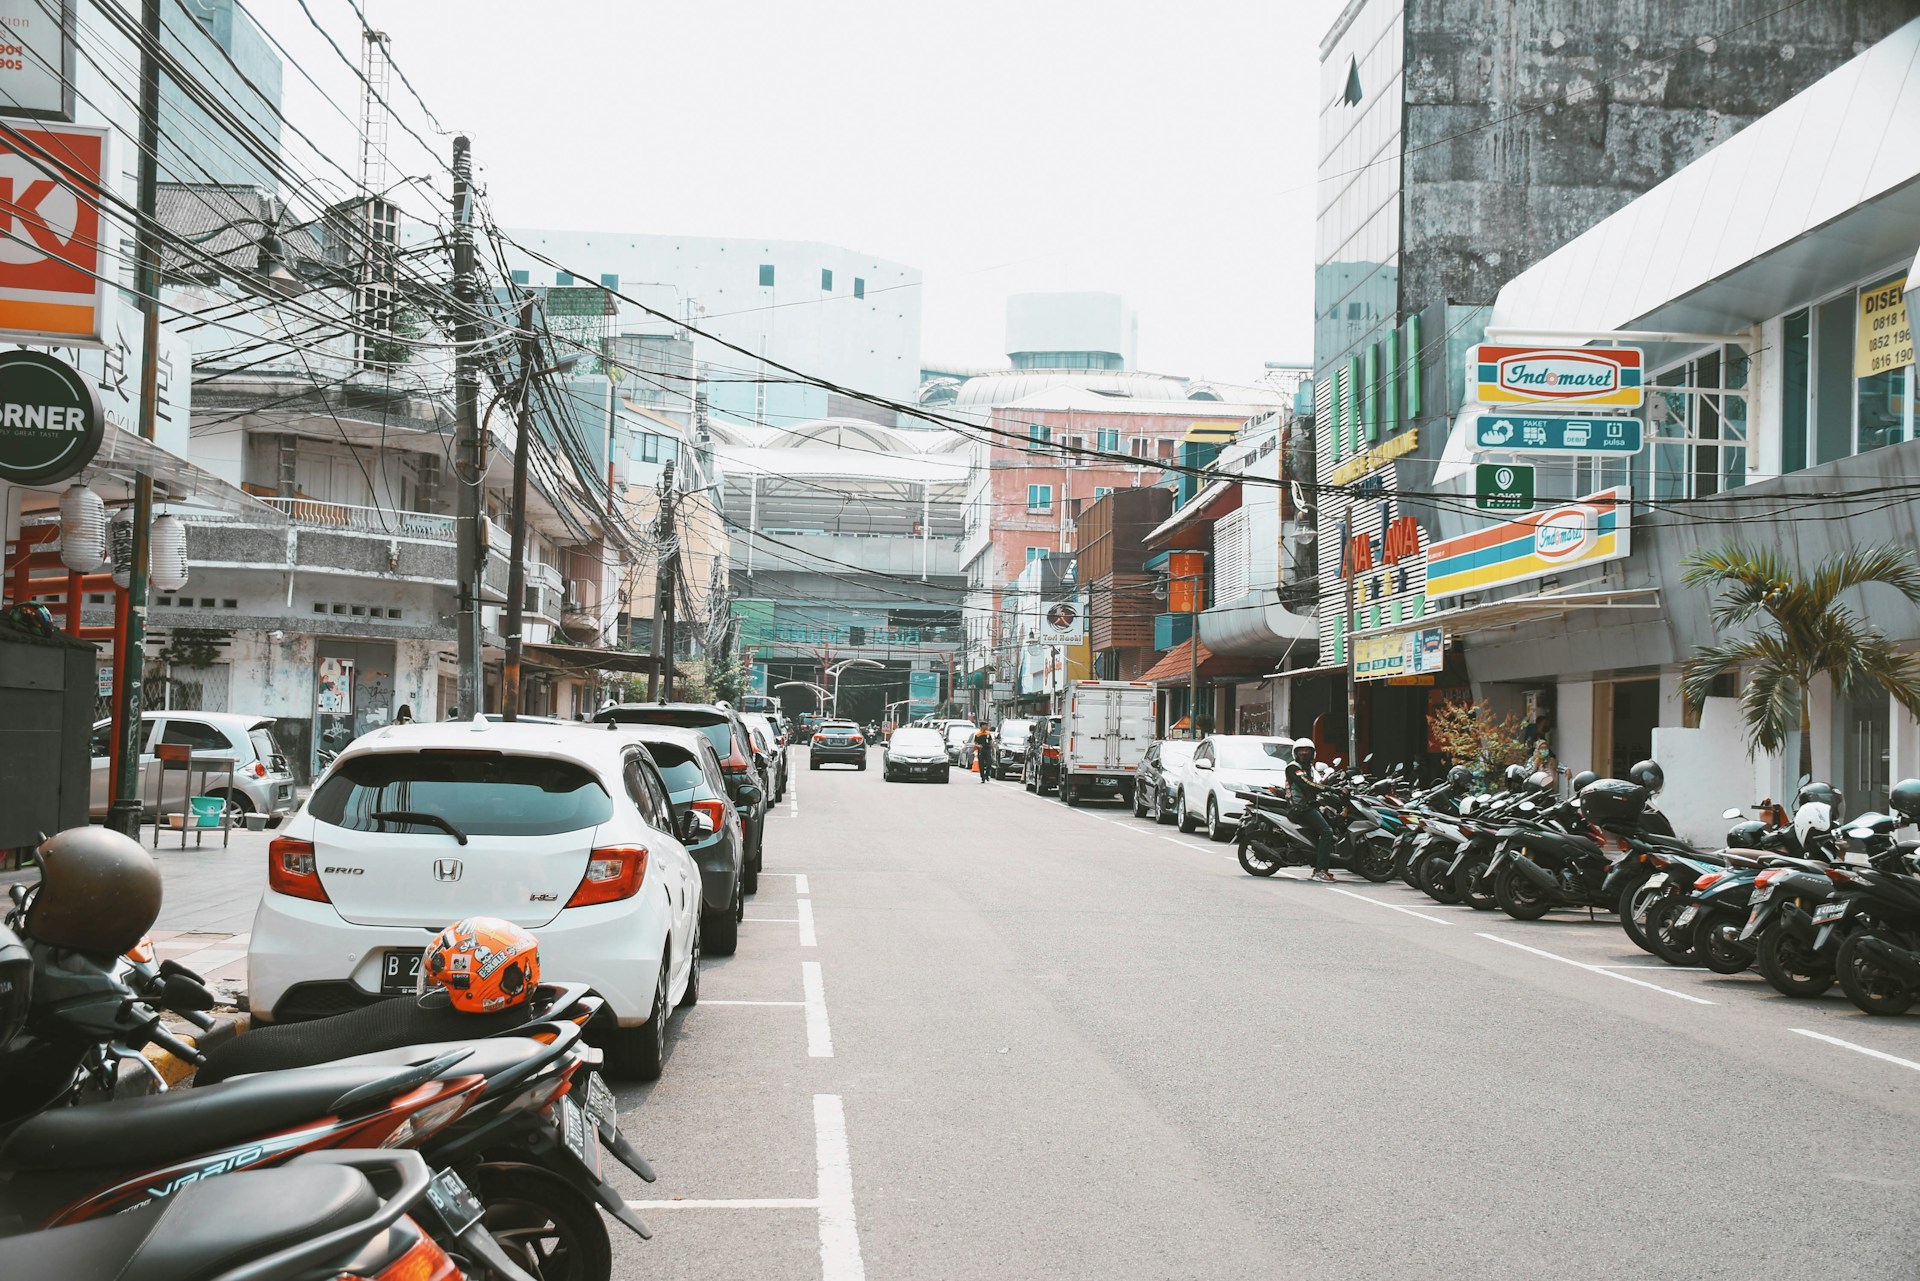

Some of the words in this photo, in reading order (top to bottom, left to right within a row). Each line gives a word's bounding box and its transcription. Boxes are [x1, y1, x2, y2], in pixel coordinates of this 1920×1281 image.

[1873, 313, 1897, 331] 0818
[1893, 328, 1911, 345] 196
[1895, 347, 1913, 362] 190
[1507, 364, 1613, 387] Indomaret
[0, 402, 85, 432] RNER
[1523, 420, 1548, 428] PAKET
[39, 431, 60, 439] TASTE
[1603, 438, 1626, 447] pulsa
[324, 866, 365, 875] BRIO
[388, 956, 399, 976] B
[147, 1147, 264, 1197] VARIO
[427, 1188, 445, 1209] B
